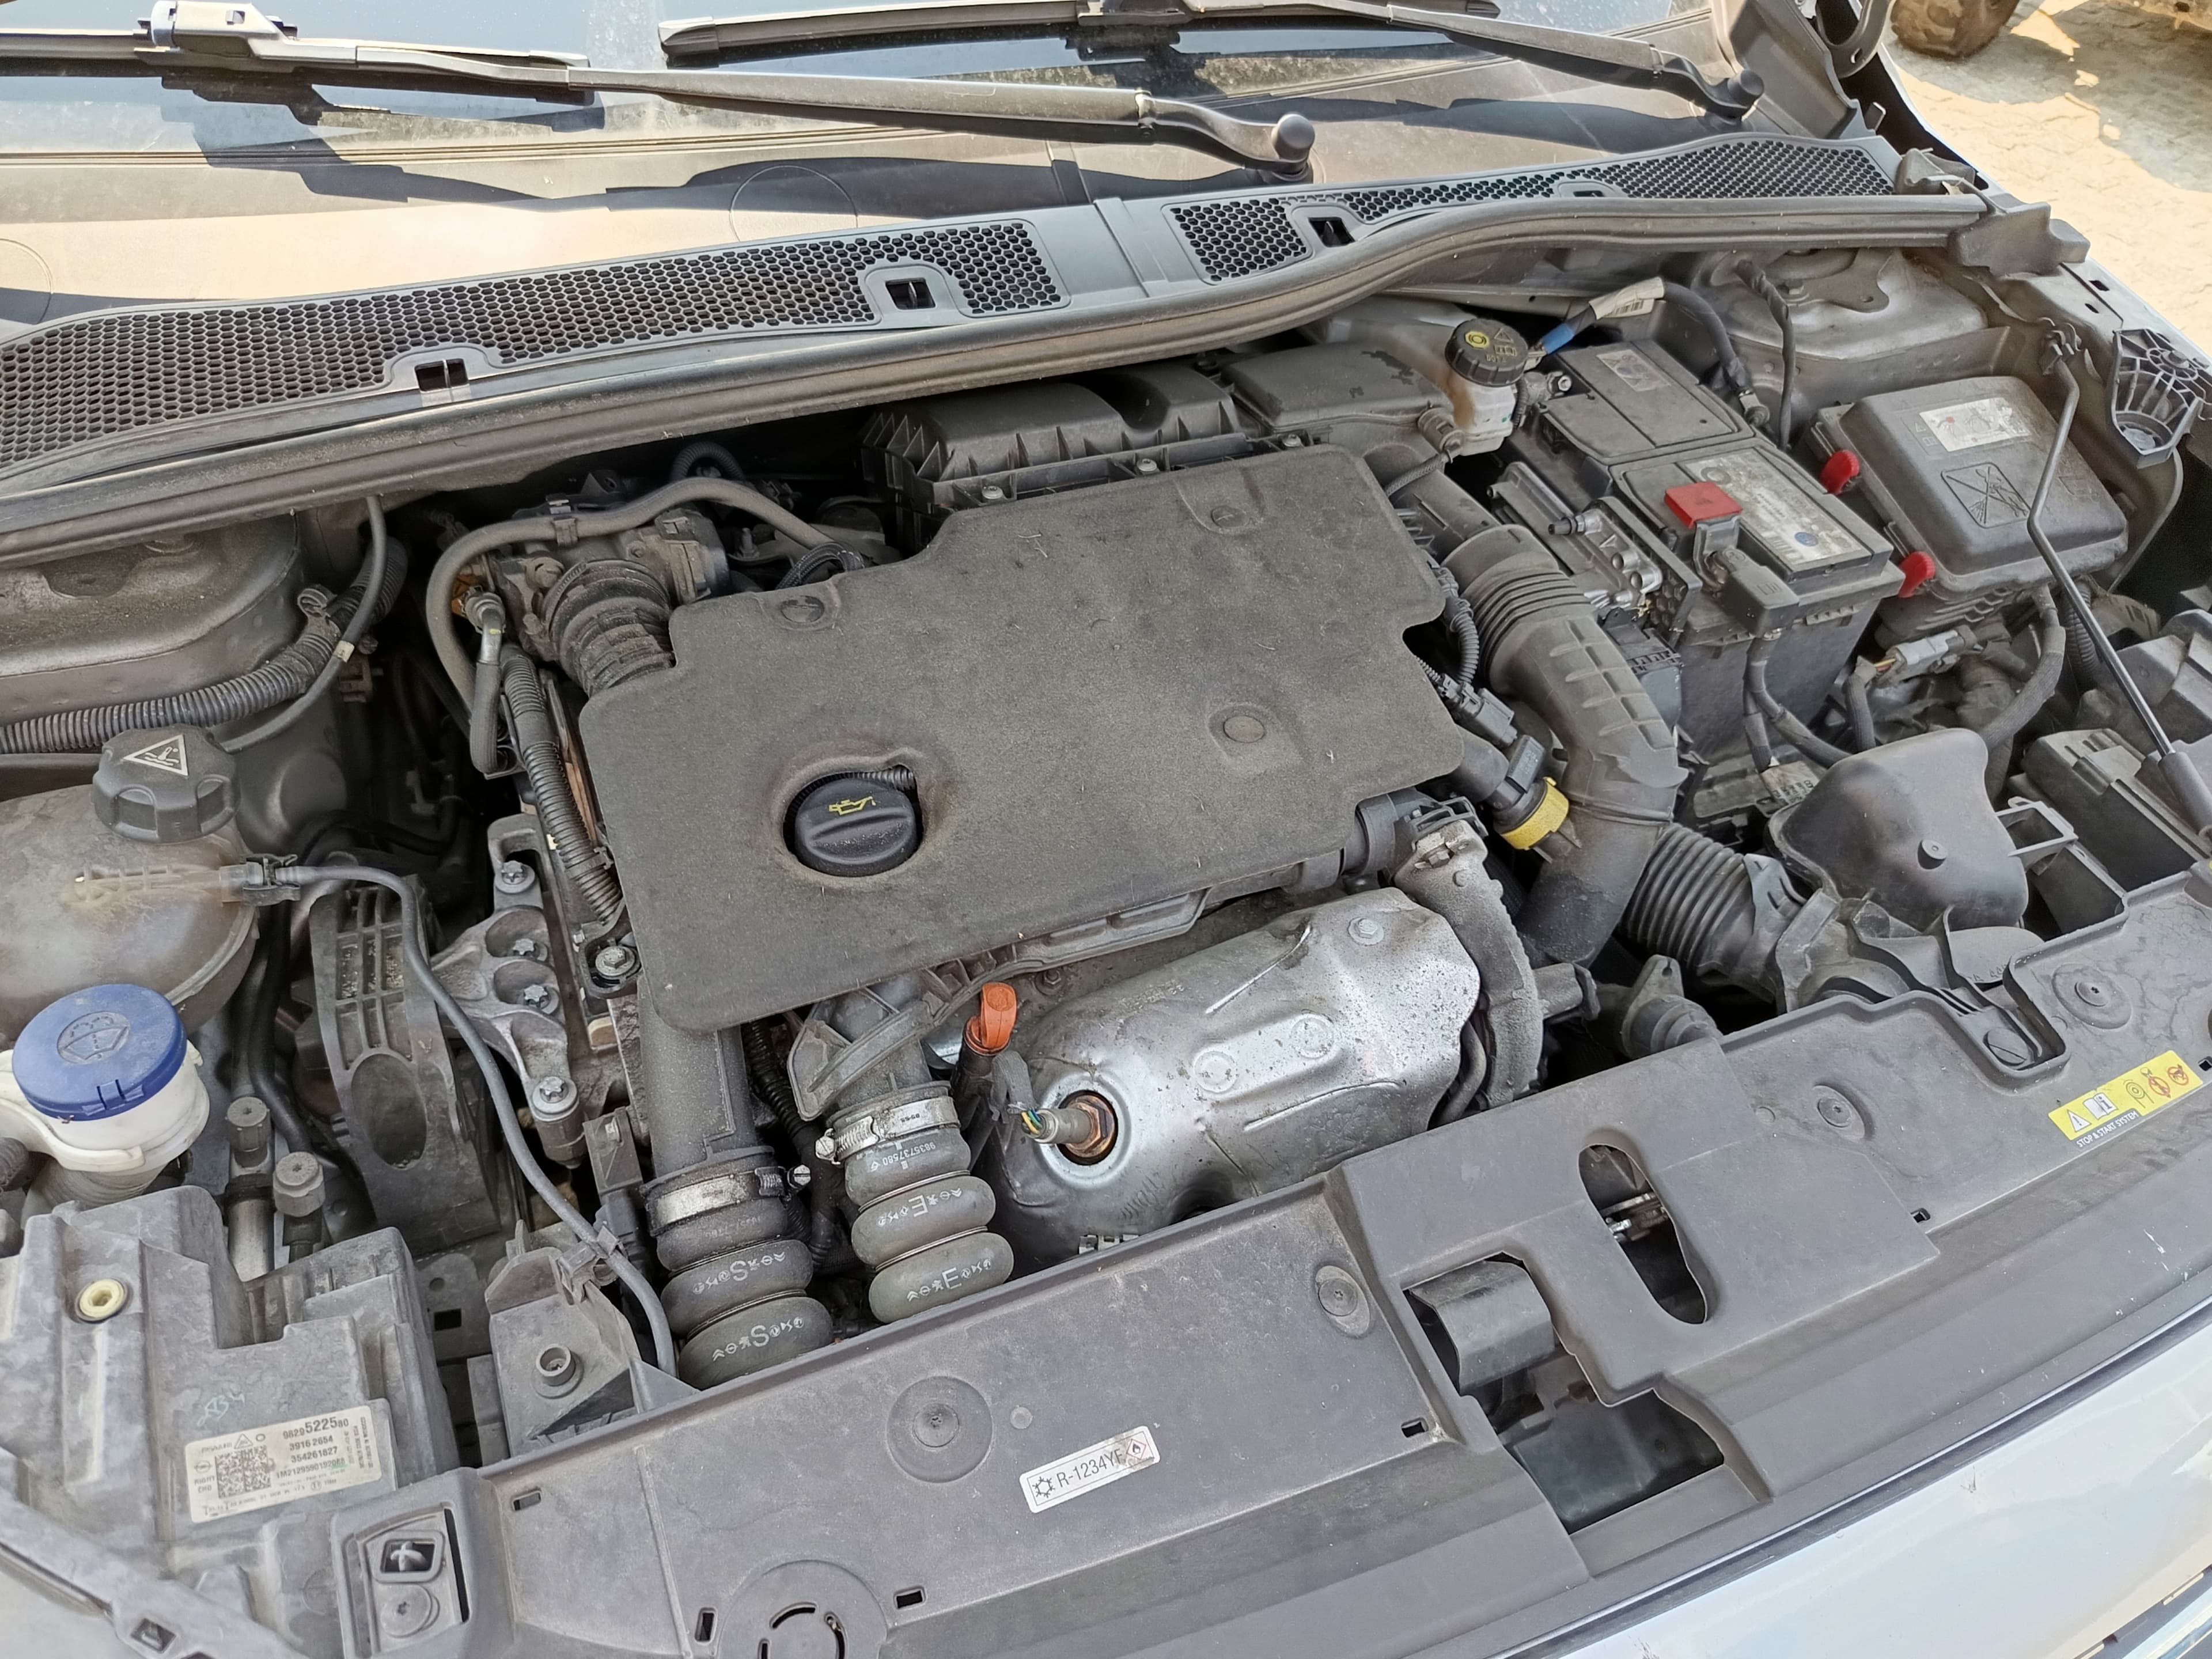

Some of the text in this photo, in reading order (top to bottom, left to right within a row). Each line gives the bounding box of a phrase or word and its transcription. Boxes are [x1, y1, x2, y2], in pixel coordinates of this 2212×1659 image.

[2076, 1134, 2093, 1147] STOP
[2097, 1122, 2117, 1137] START
[2115, 1111, 2139, 1127] SYSTEM
[882, 1141, 935, 1166] 9835737580
[289, 1435, 334, 1452] 3916 2654
[291, 1446, 339, 1464] 354261827
[1056, 1448, 1123, 1488] R-1234YF
